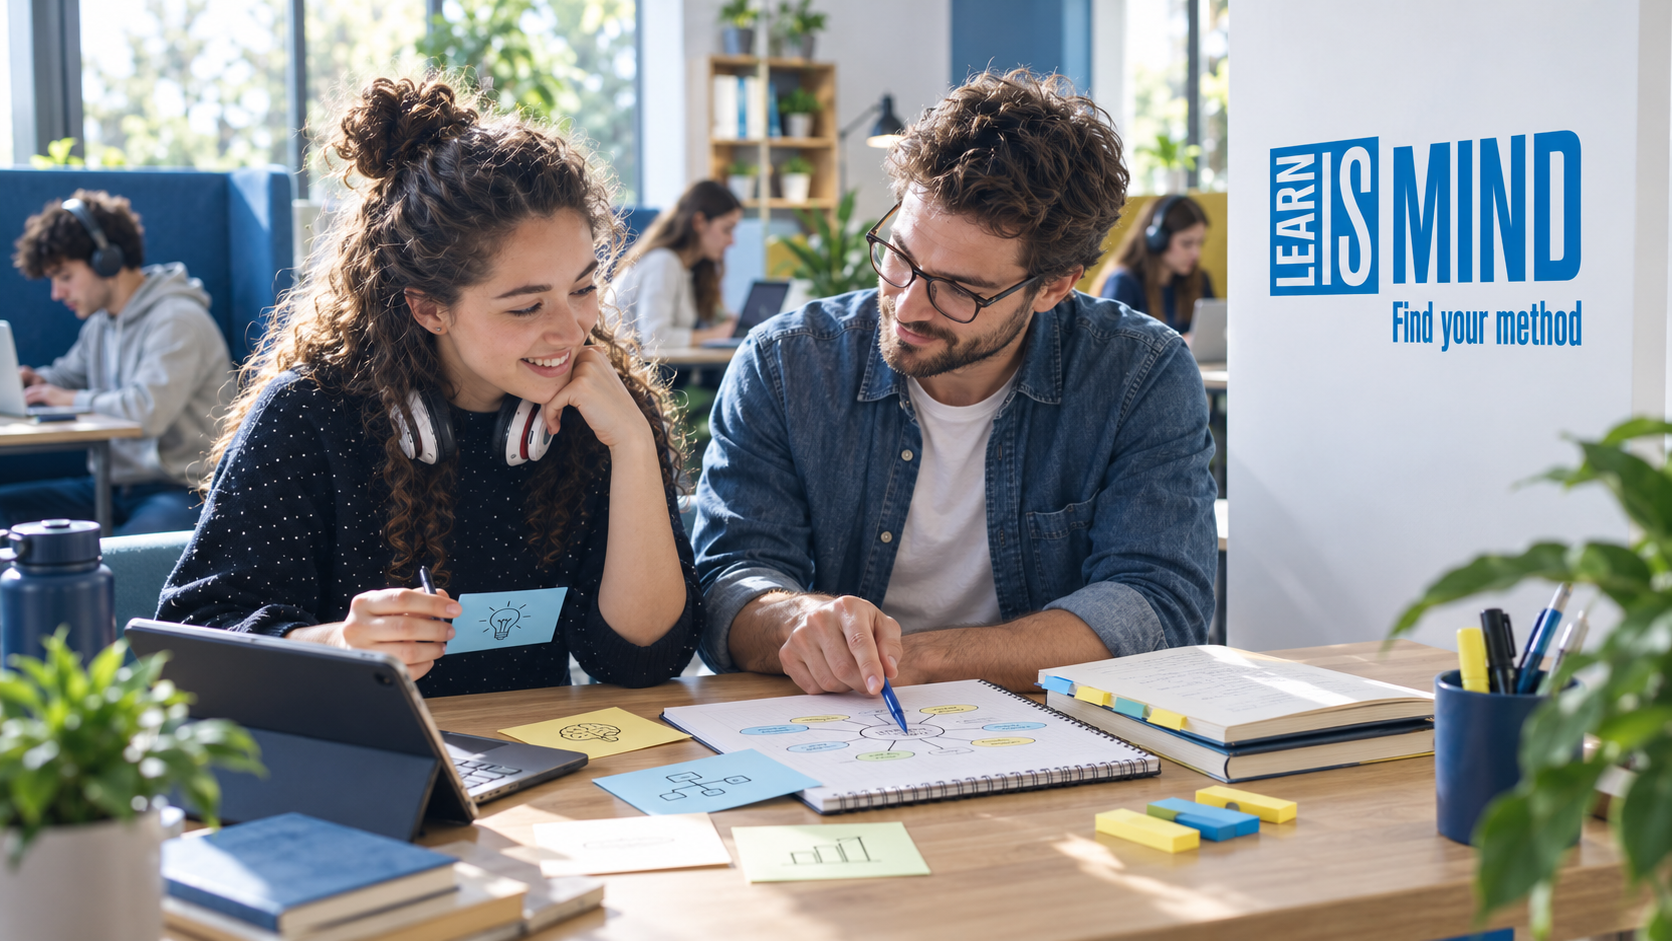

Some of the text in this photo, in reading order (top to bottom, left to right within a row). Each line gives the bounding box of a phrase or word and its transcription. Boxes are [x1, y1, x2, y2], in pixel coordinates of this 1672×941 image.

[1276, 130, 1582, 287] LEARN IS MIND
[1393, 300, 1582, 352] Find your method
